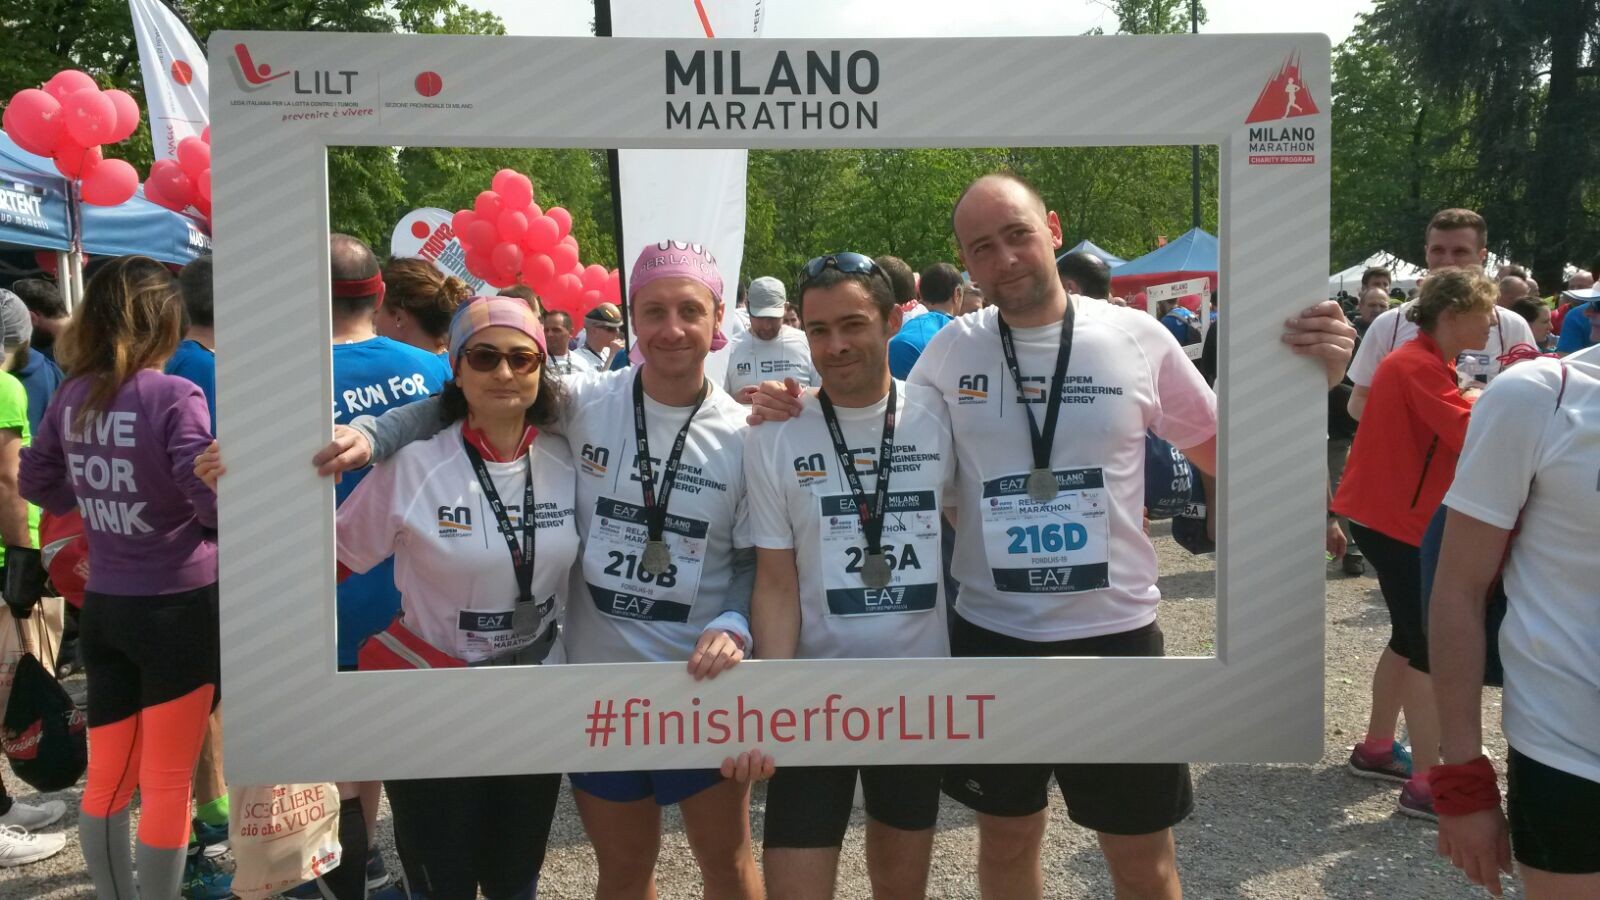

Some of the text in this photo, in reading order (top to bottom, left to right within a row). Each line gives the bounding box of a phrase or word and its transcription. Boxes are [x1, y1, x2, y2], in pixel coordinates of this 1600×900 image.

[665, 50, 880, 95] MILANO
[294, 70, 358, 94] LILT
[282, 112, 329, 122] prevenire
[342, 108, 374, 117] vivere
[666, 101, 878, 130] MARATHON
[1249, 127, 1315, 142] MILANO
[1249, 142, 1315, 152] MARATHON
[1250, 156, 1279, 164] CHARITY
[0, 188, 42, 217] RTENT
[639, 256, 666, 274] PER
[670, 254, 690, 265] LA
[959, 374, 989, 392] 60
[1062, 385, 1124, 396] NGINEERING
[343, 384, 388, 414] RUN
[388, 373, 430, 400] FOR
[1061, 396, 1096, 404] NERGY
[63, 406, 137, 448] LIVE
[581, 444, 610, 468] 60
[794, 452, 826, 472] 60
[890, 453, 941, 463] NGINEERING
[68, 453, 138, 492] FOR
[889, 463, 922, 473] NERGY
[671, 481, 702, 495] ERGY
[674, 472, 728, 492] GINEERING
[1000, 478, 1026, 490] EA7
[888, 495, 920, 503] MILANO
[438, 506, 472, 525] 60
[613, 504, 639, 518] EA7
[1019, 504, 1072, 514] MARATHON
[1184, 504, 1199, 516] 6A
[534, 518, 565, 530] NERGY
[625, 526, 647, 538] RELA
[1006, 522, 1088, 554] 216D
[1028, 568, 1073, 586] EA7
[612, 593, 656, 615] EA7
[864, 586, 906, 606] EA7
[477, 616, 504, 627] EA7
[584, 693, 996, 747] #finisherforLILT
[244, 784, 325, 820] SCEGLIERE
[261, 822, 282, 837] che
[283, 803, 326, 831] VUOI
